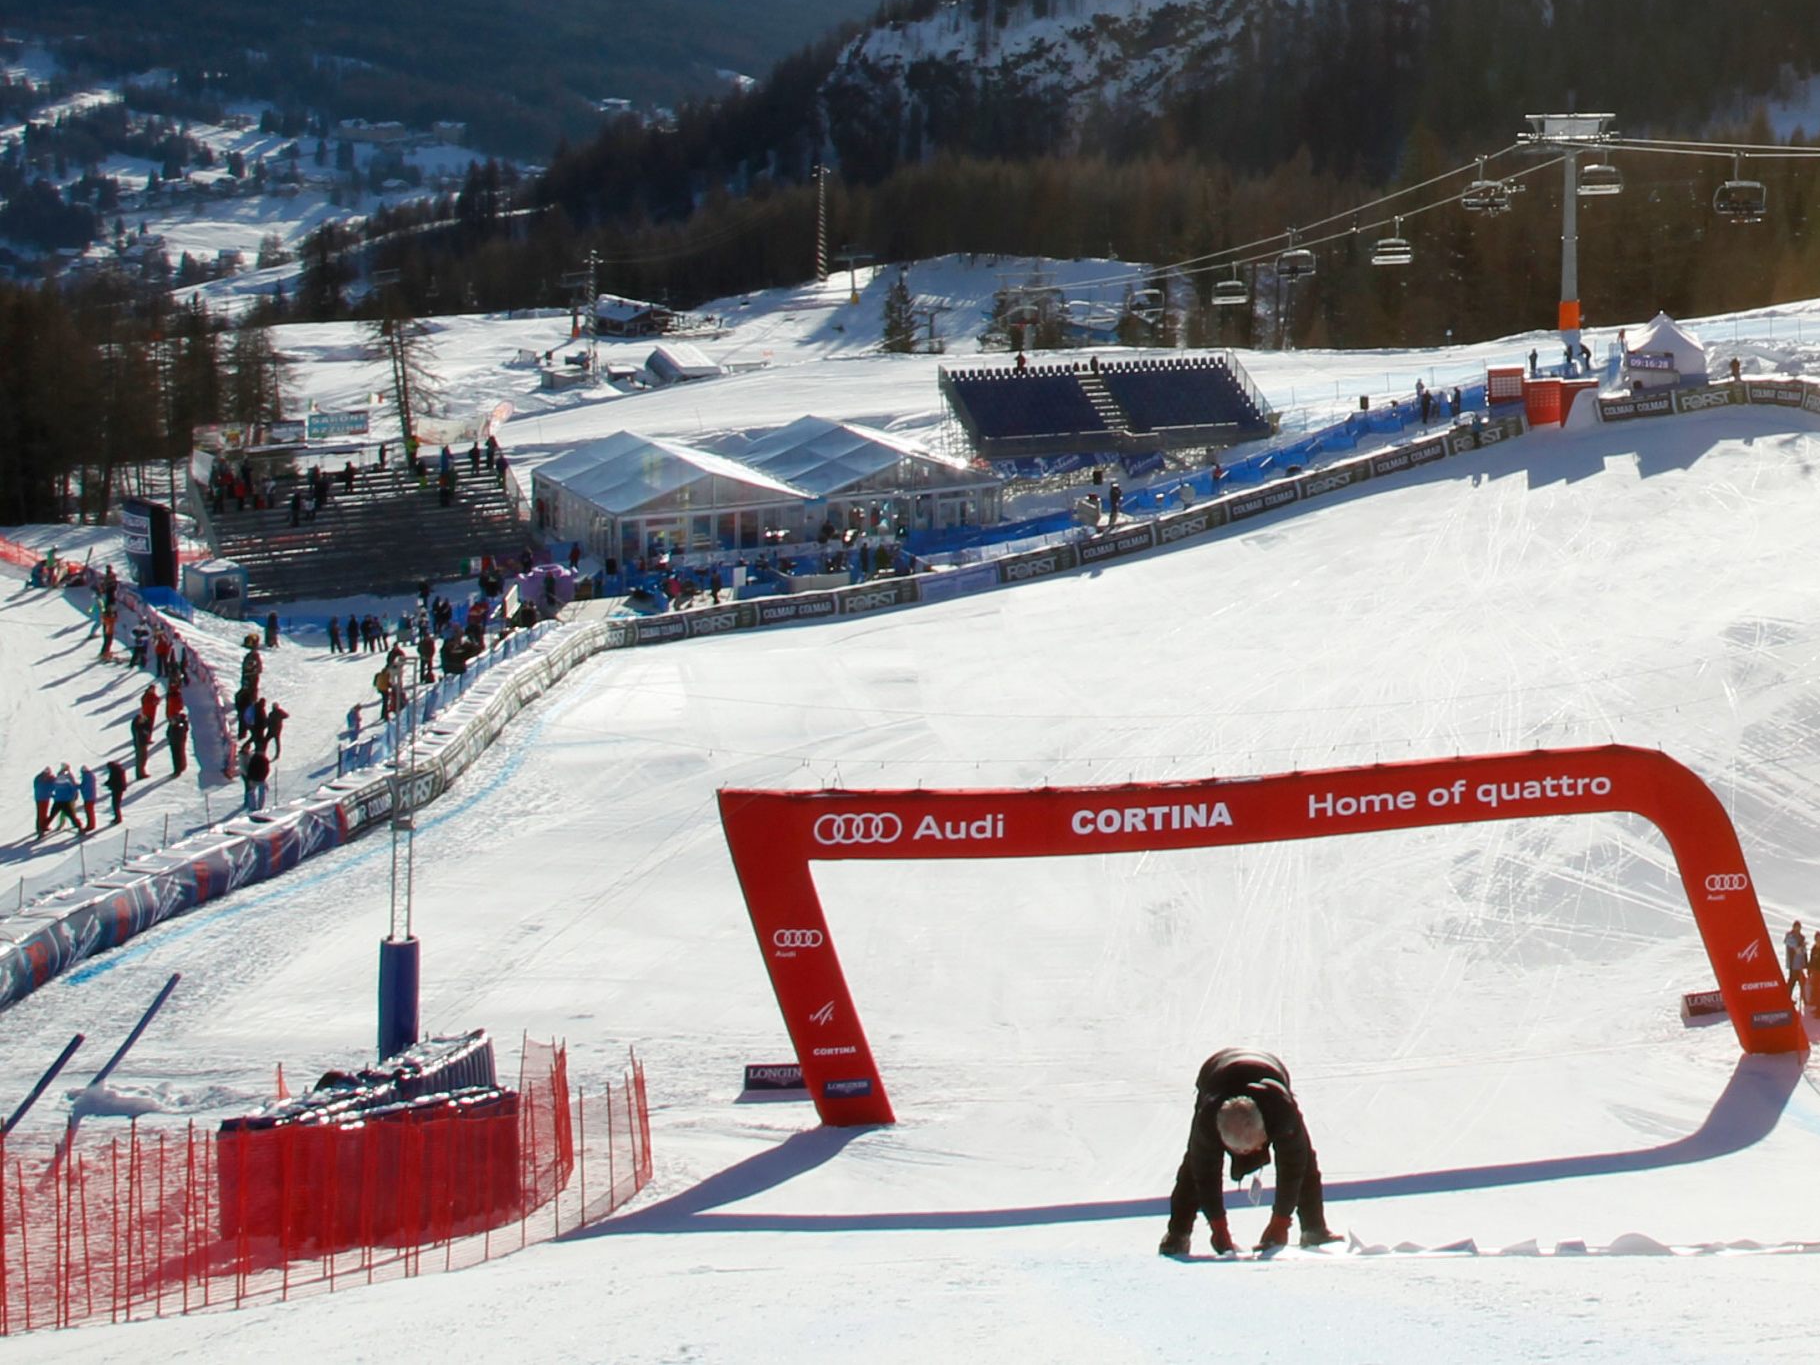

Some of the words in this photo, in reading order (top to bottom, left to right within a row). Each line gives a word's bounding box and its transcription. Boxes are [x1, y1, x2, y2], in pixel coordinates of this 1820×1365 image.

[1630, 359, 1669, 369] 09:16:28
[1603, 405, 1635, 416] COLMAR
[1637, 400, 1670, 412] COLMAR
[1682, 391, 1731, 410] FORST
[1377, 456, 1408, 473] COLMAR
[1411, 445, 1441, 463] COLMAR
[1233, 499, 1263, 516] COLMAR
[1265, 490, 1294, 507] COLMAR
[1162, 516, 1208, 542] FORST
[1083, 543, 1115, 560] COLMAR
[1118, 534, 1149, 552] COLMAR
[1006, 557, 1057, 580] FORST
[763, 607, 795, 620] COLMAR
[798, 601, 832, 614] COLMAR
[845, 589, 898, 611] FORST
[692, 611, 739, 635] FORST
[913, 814, 1004, 841] Audi
[1071, 802, 1232, 835] CORTINA
[1308, 791, 1417, 819] Home
[1427, 780, 1467, 807] of
[1476, 776, 1612, 807] quattro
[775, 949, 796, 958] Audi
[813, 1046, 857, 1056] CORTINA
[750, 1068, 801, 1079] LONGIN
